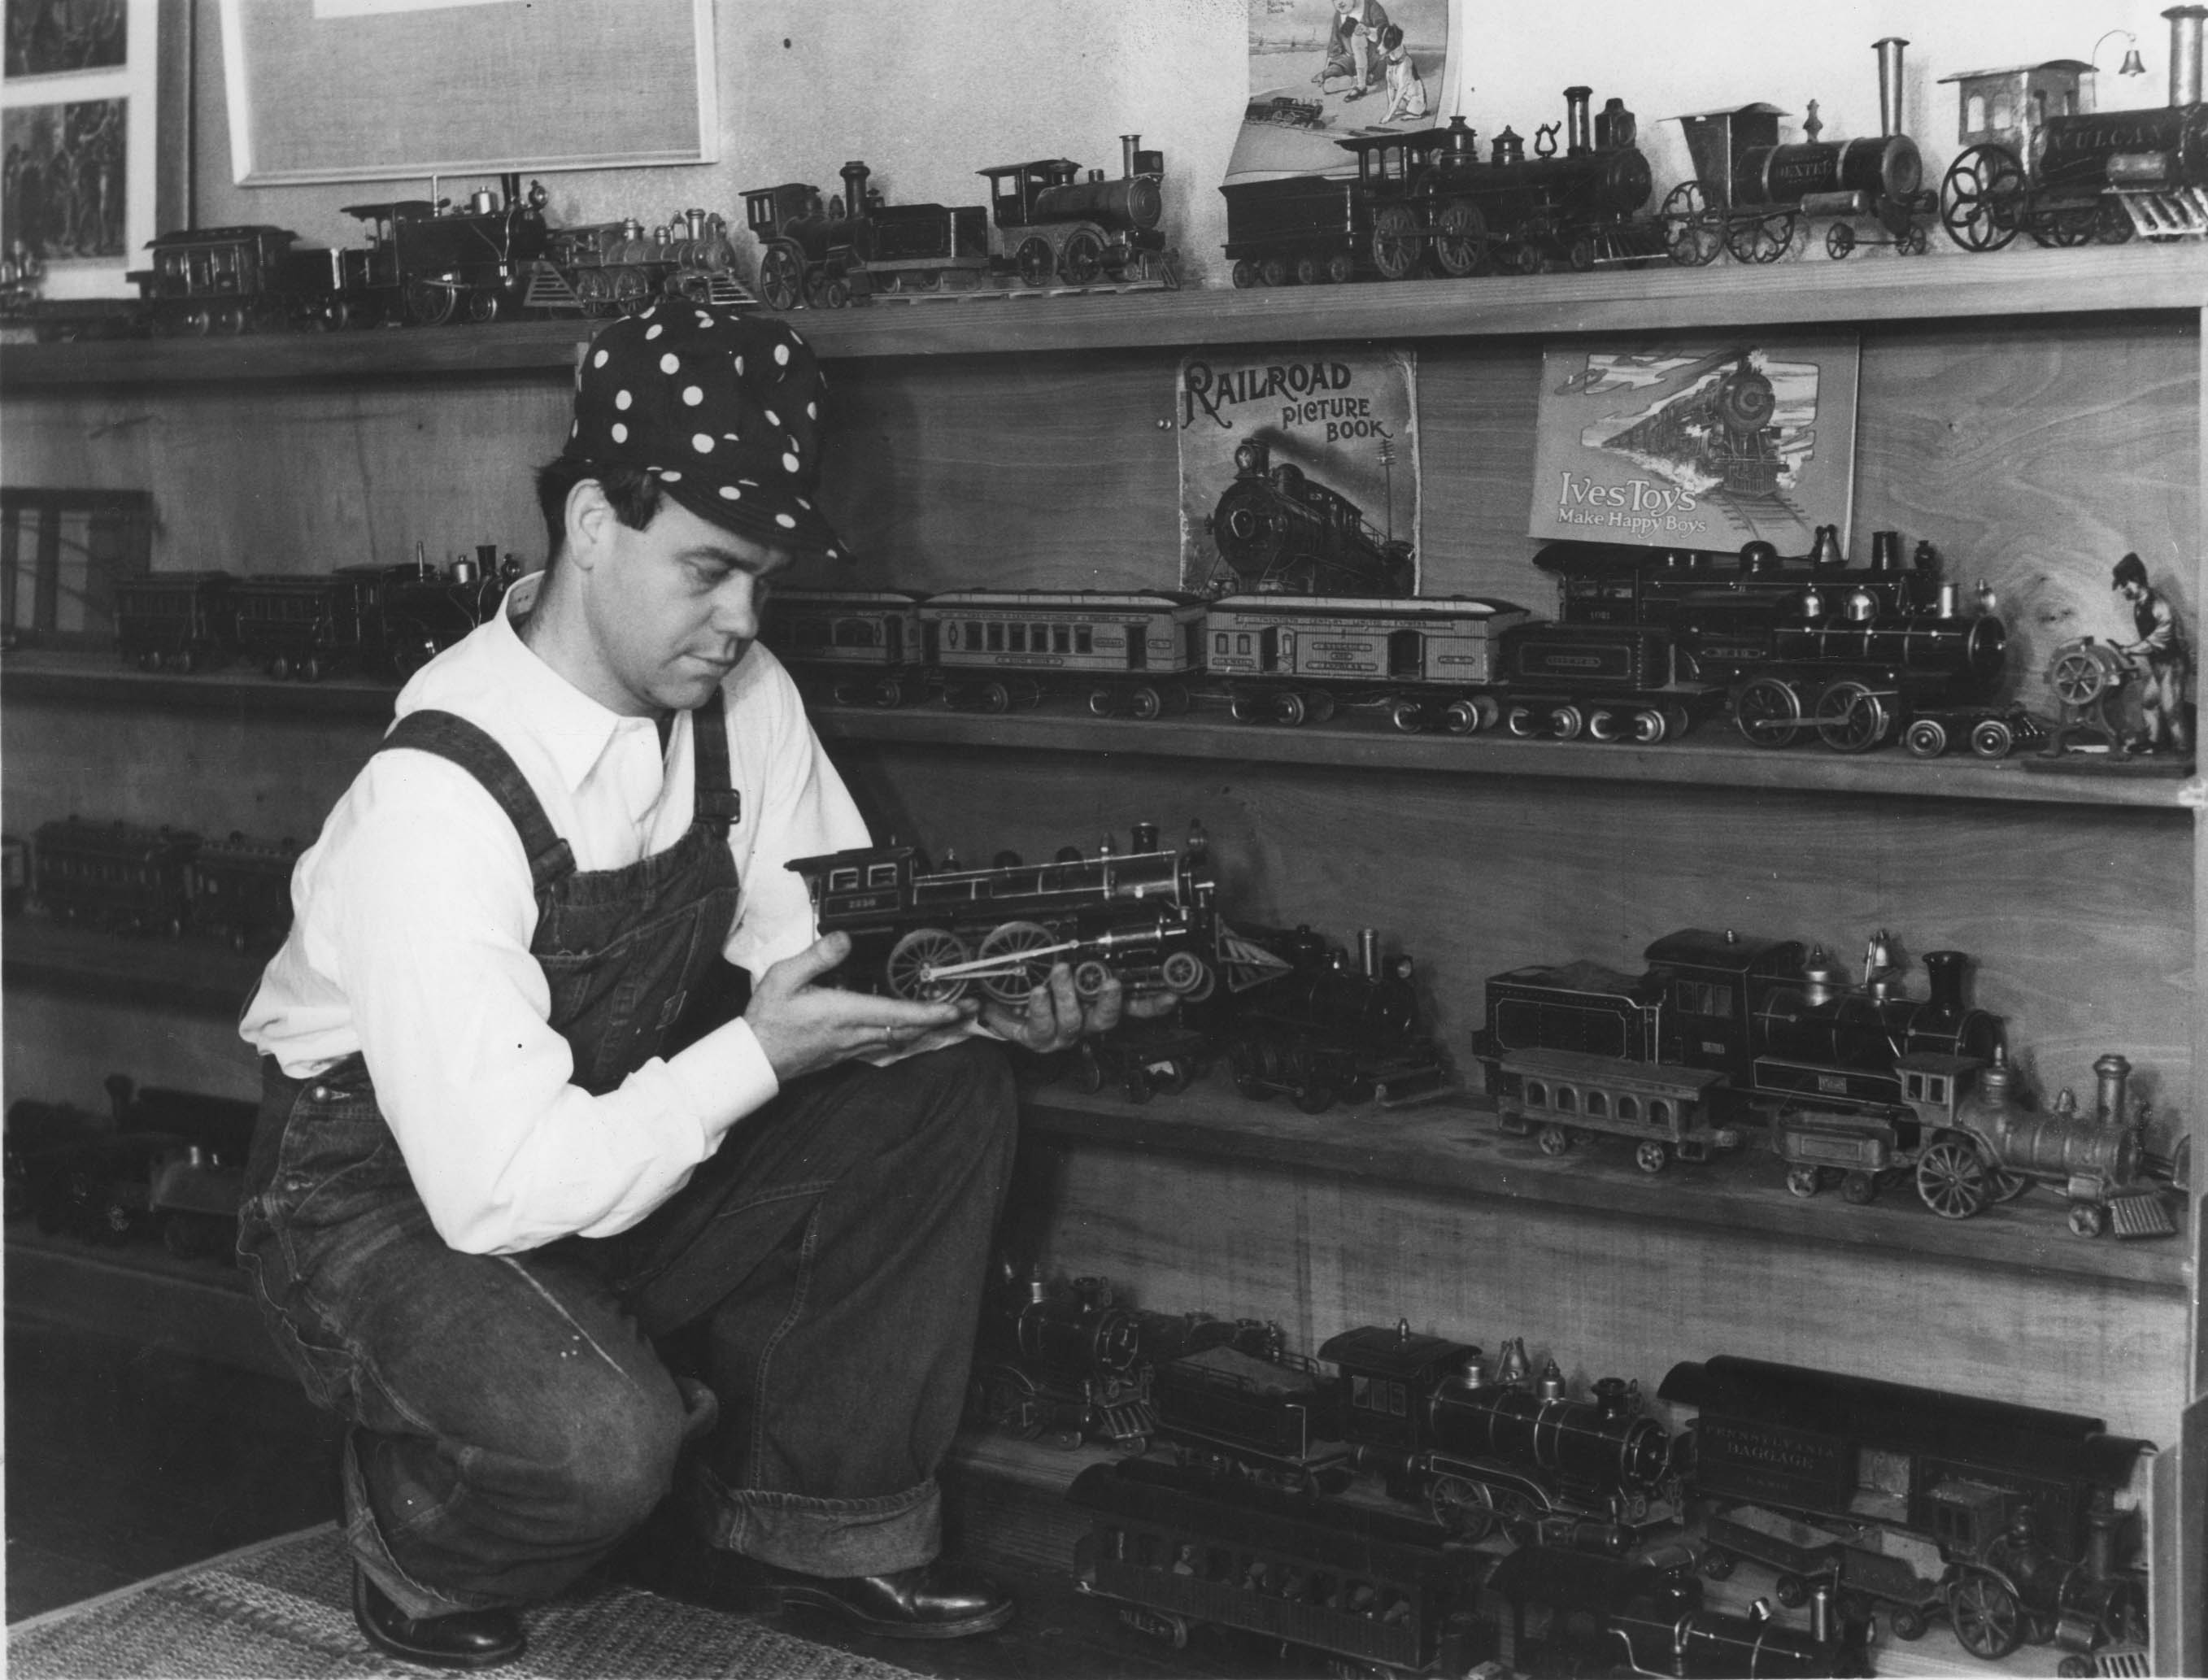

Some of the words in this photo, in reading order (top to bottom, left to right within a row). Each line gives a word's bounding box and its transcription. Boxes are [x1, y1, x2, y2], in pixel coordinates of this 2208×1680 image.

[1181, 361, 1352, 429] RAILROAD
[1326, 420, 1394, 443] BOOK
[1559, 471, 1626, 507] Ives
[1626, 478, 1697, 518] Toys
[1557, 507, 1605, 524] Make
[1608, 511, 1662, 539] Happy
[1666, 515, 1706, 538] Boys
